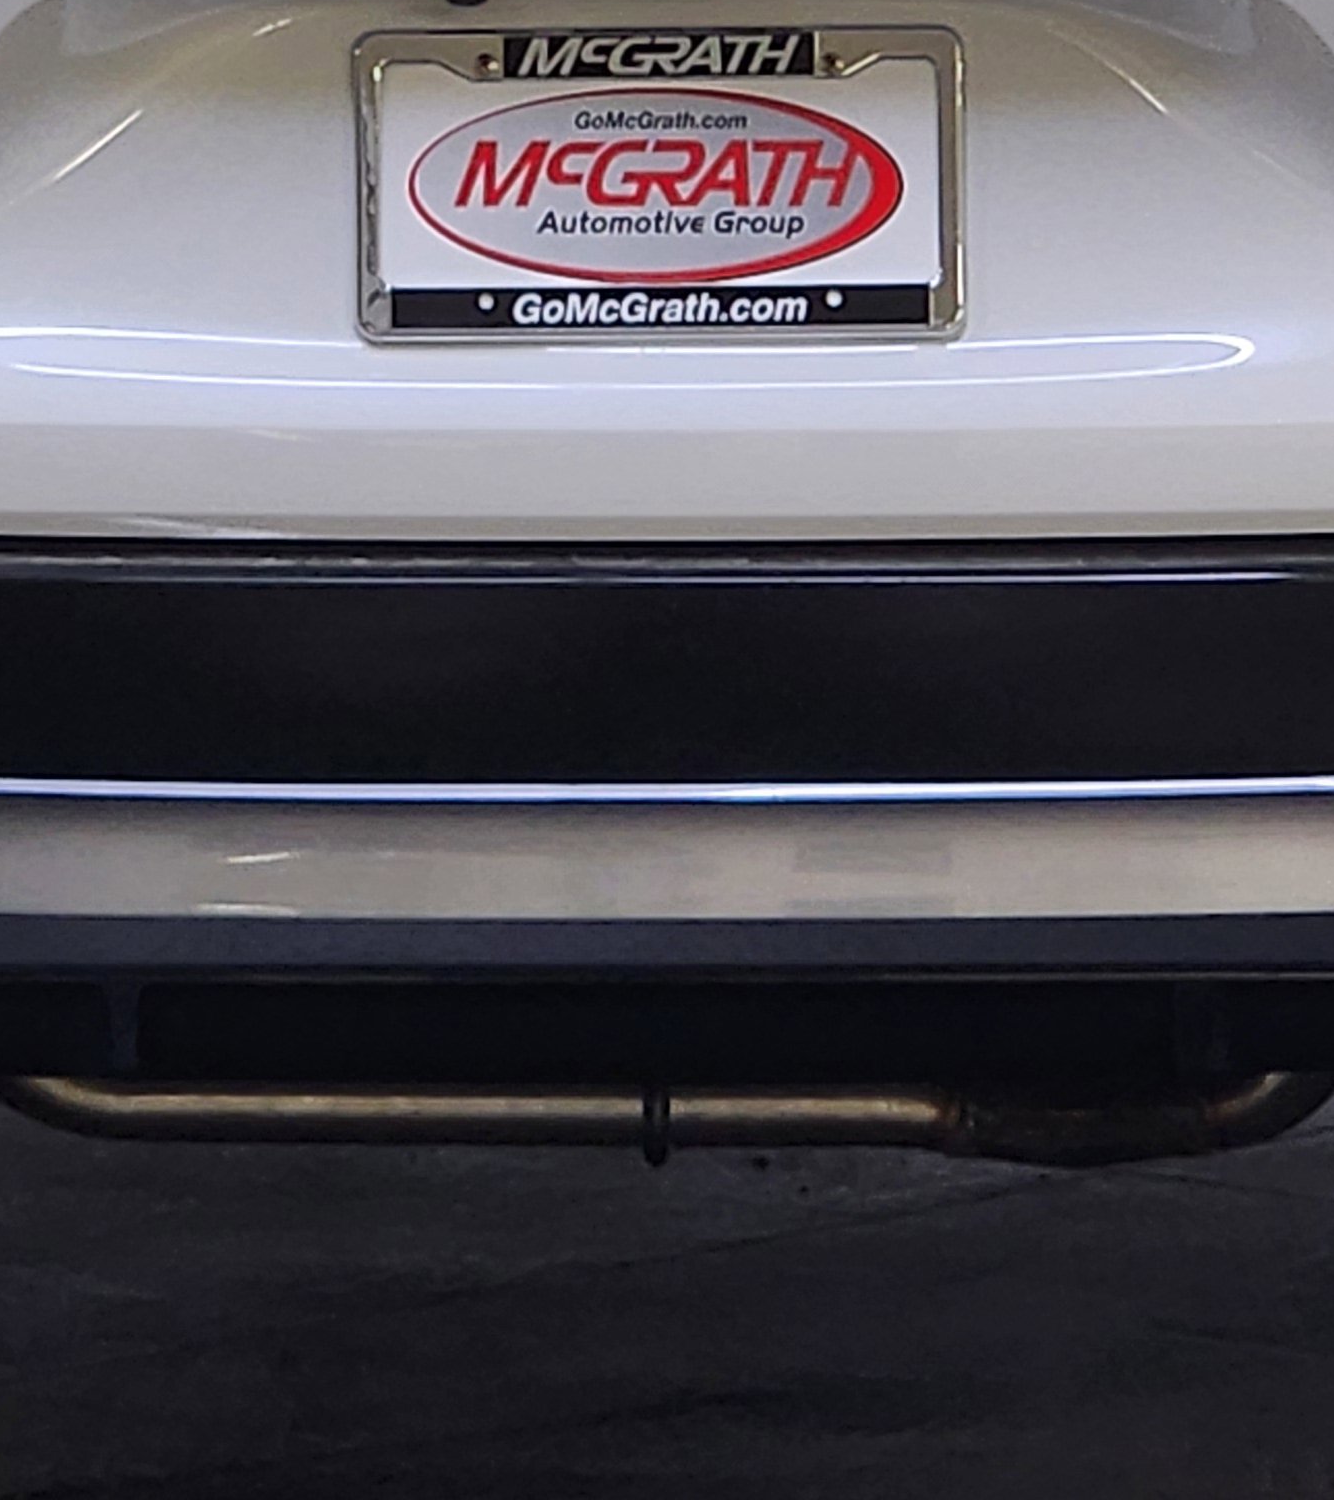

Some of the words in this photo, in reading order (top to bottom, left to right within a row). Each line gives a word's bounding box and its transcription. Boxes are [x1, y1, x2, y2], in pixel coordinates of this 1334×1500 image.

[575, 111, 747, 131] GoMcGrath.com
[536, 210, 704, 235] Automotive
[714, 211, 805, 239] Group
[512, 292, 808, 324] GoMcGrath.com
